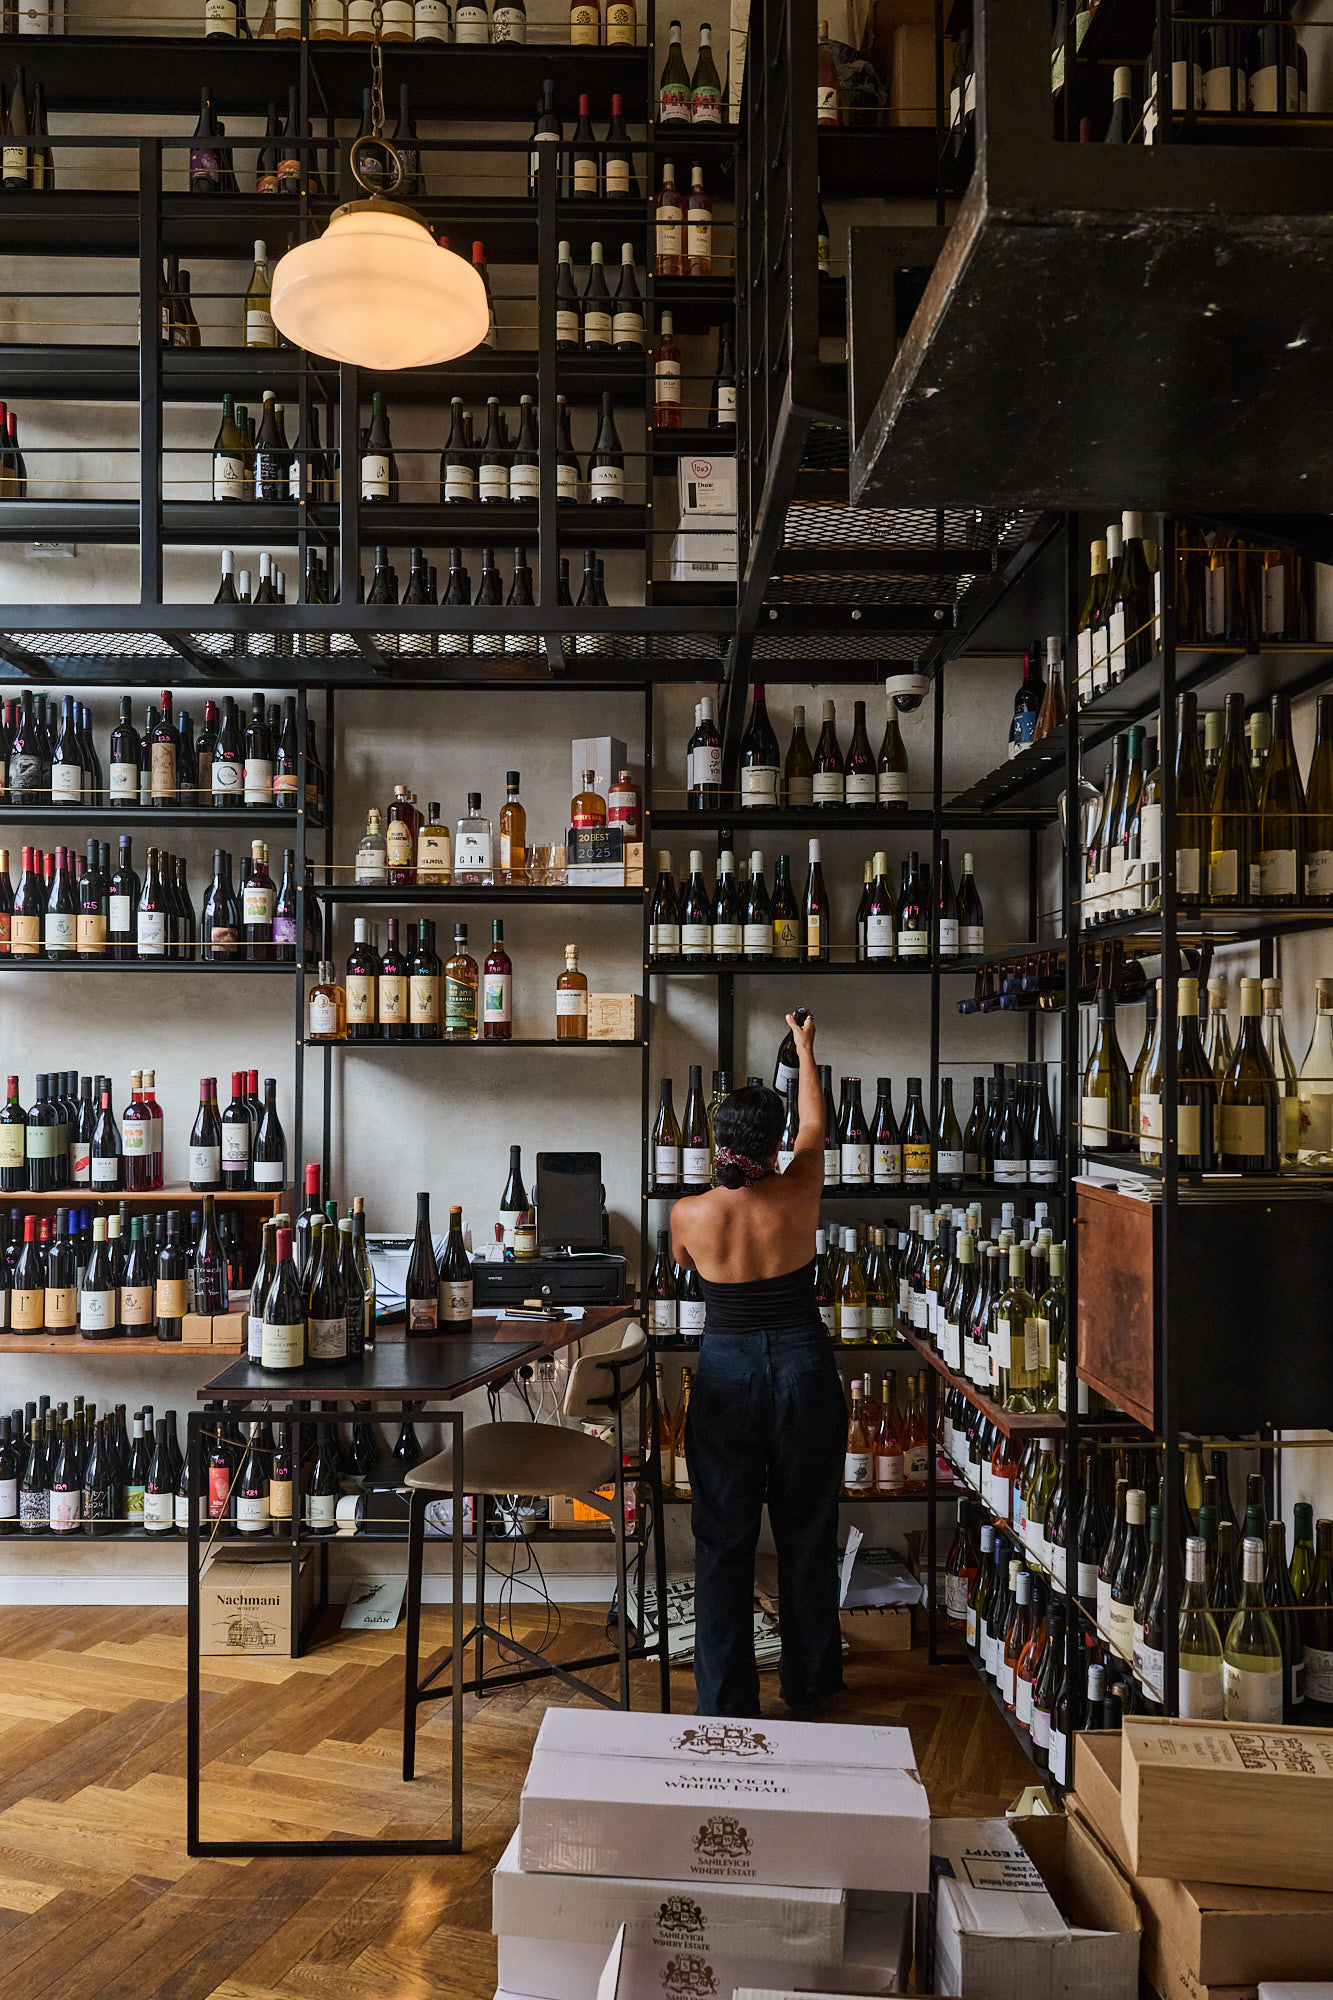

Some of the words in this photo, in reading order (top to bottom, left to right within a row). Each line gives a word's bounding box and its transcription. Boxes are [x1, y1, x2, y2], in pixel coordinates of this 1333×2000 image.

[591, 833, 610, 841] BEST
[579, 847, 612, 858] 2025
[460, 856, 484, 864] GIN
[217, 1594, 280, 1606] Nachmani
[679, 1774, 776, 1786] SANILEVICH
[664, 1780, 729, 1791] WINERY
[734, 1784, 791, 1794] ESTATE
[964, 1848, 1010, 1858] EGYPT
[697, 1857, 750, 1868] SANILEVICH
[690, 1865, 724, 1876] WINERY
[726, 1868, 757, 1878] ESTATE
[659, 1931, 704, 1941] SANILEVICH
[652, 1938, 682, 1949] WINERY
[684, 1941, 711, 1951] ESTATE
